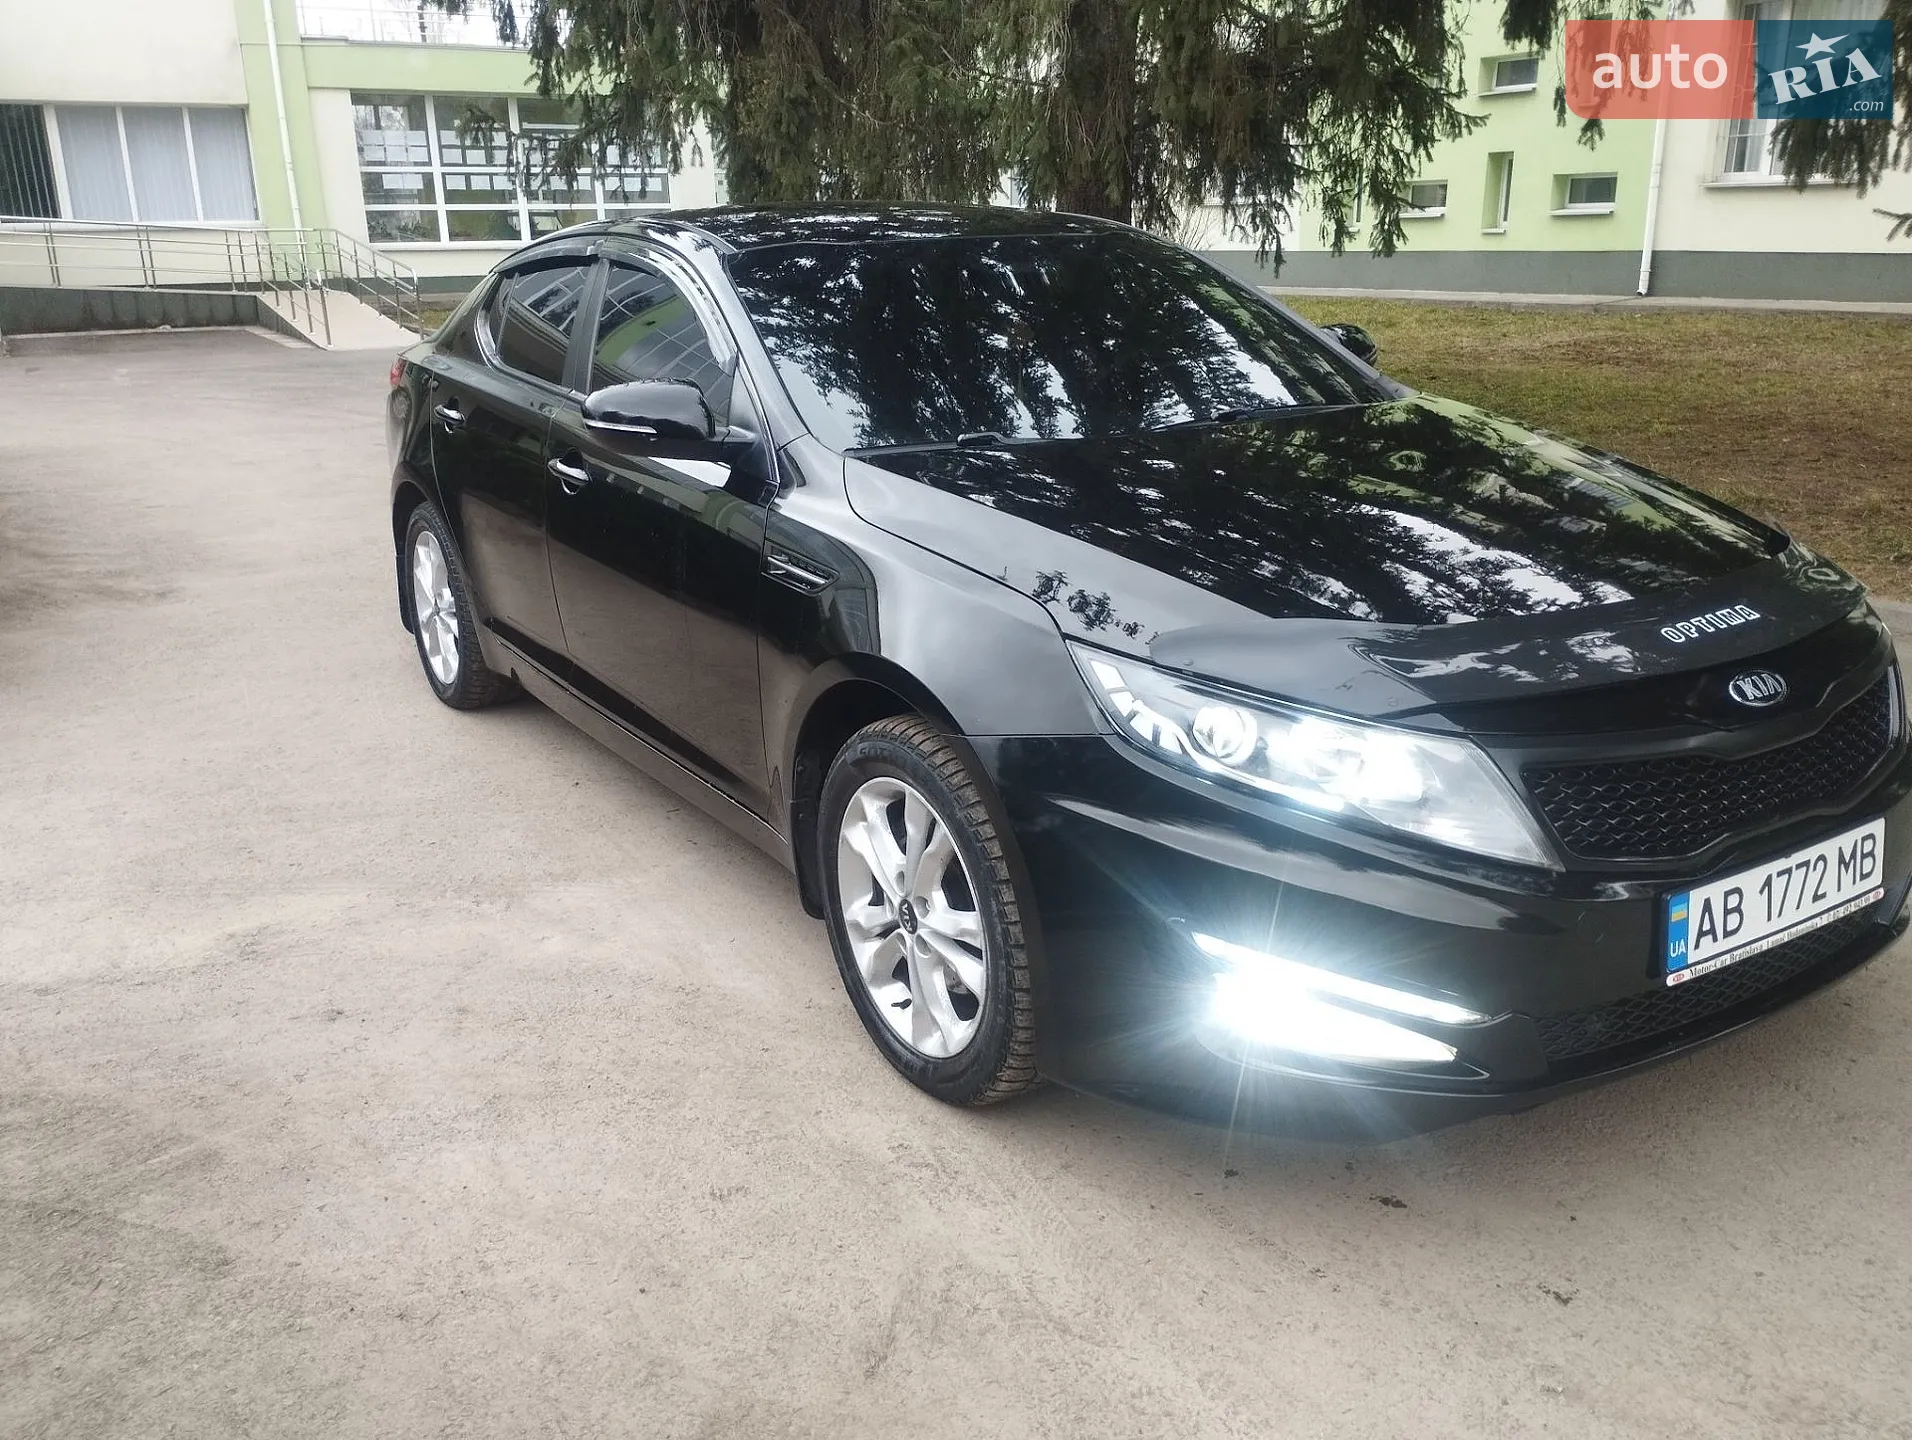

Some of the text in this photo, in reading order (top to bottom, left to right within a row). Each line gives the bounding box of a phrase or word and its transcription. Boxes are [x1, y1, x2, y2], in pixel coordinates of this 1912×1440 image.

[1660, 604, 1761, 643] OPTIMA
[1736, 673, 1782, 700] KIA
[1694, 832, 1877, 951] AB 1772 MB
[901, 902, 913, 932] KIA
[1670, 939, 1686, 958] UA
